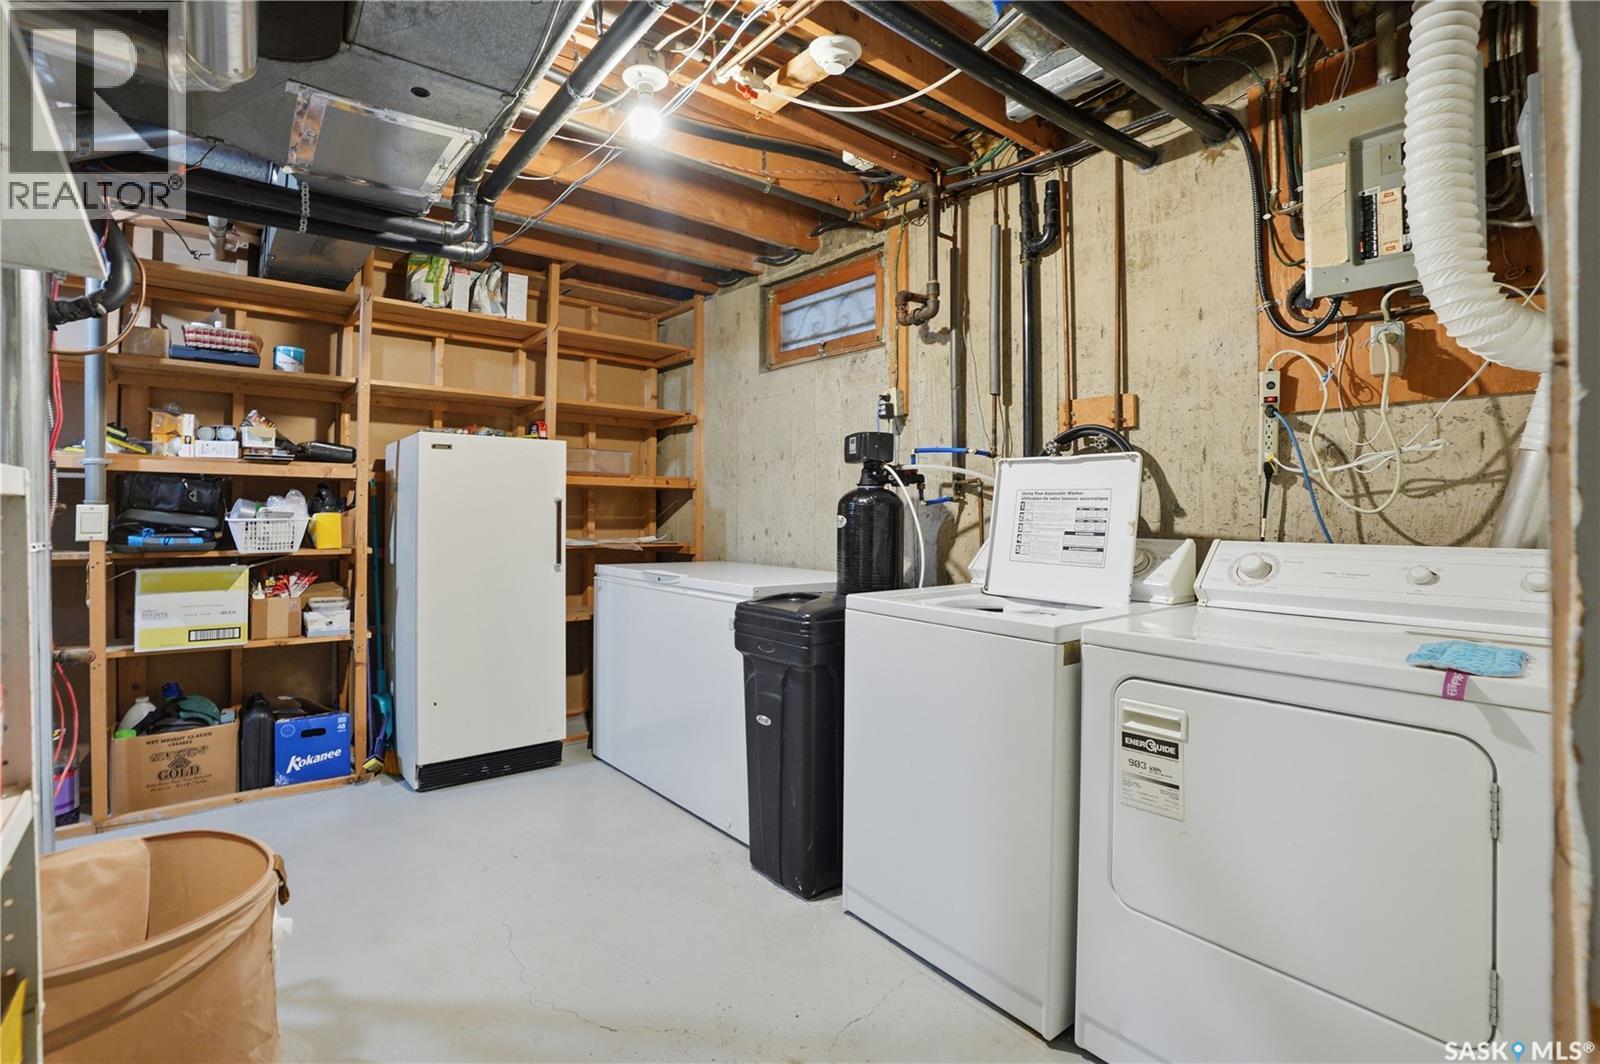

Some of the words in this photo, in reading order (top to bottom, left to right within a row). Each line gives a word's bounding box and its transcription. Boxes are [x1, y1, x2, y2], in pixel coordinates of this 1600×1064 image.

[286, 748, 342, 775] Kokanee
[1128, 758, 1147, 770] 903
[158, 765, 200, 781] GOLD
